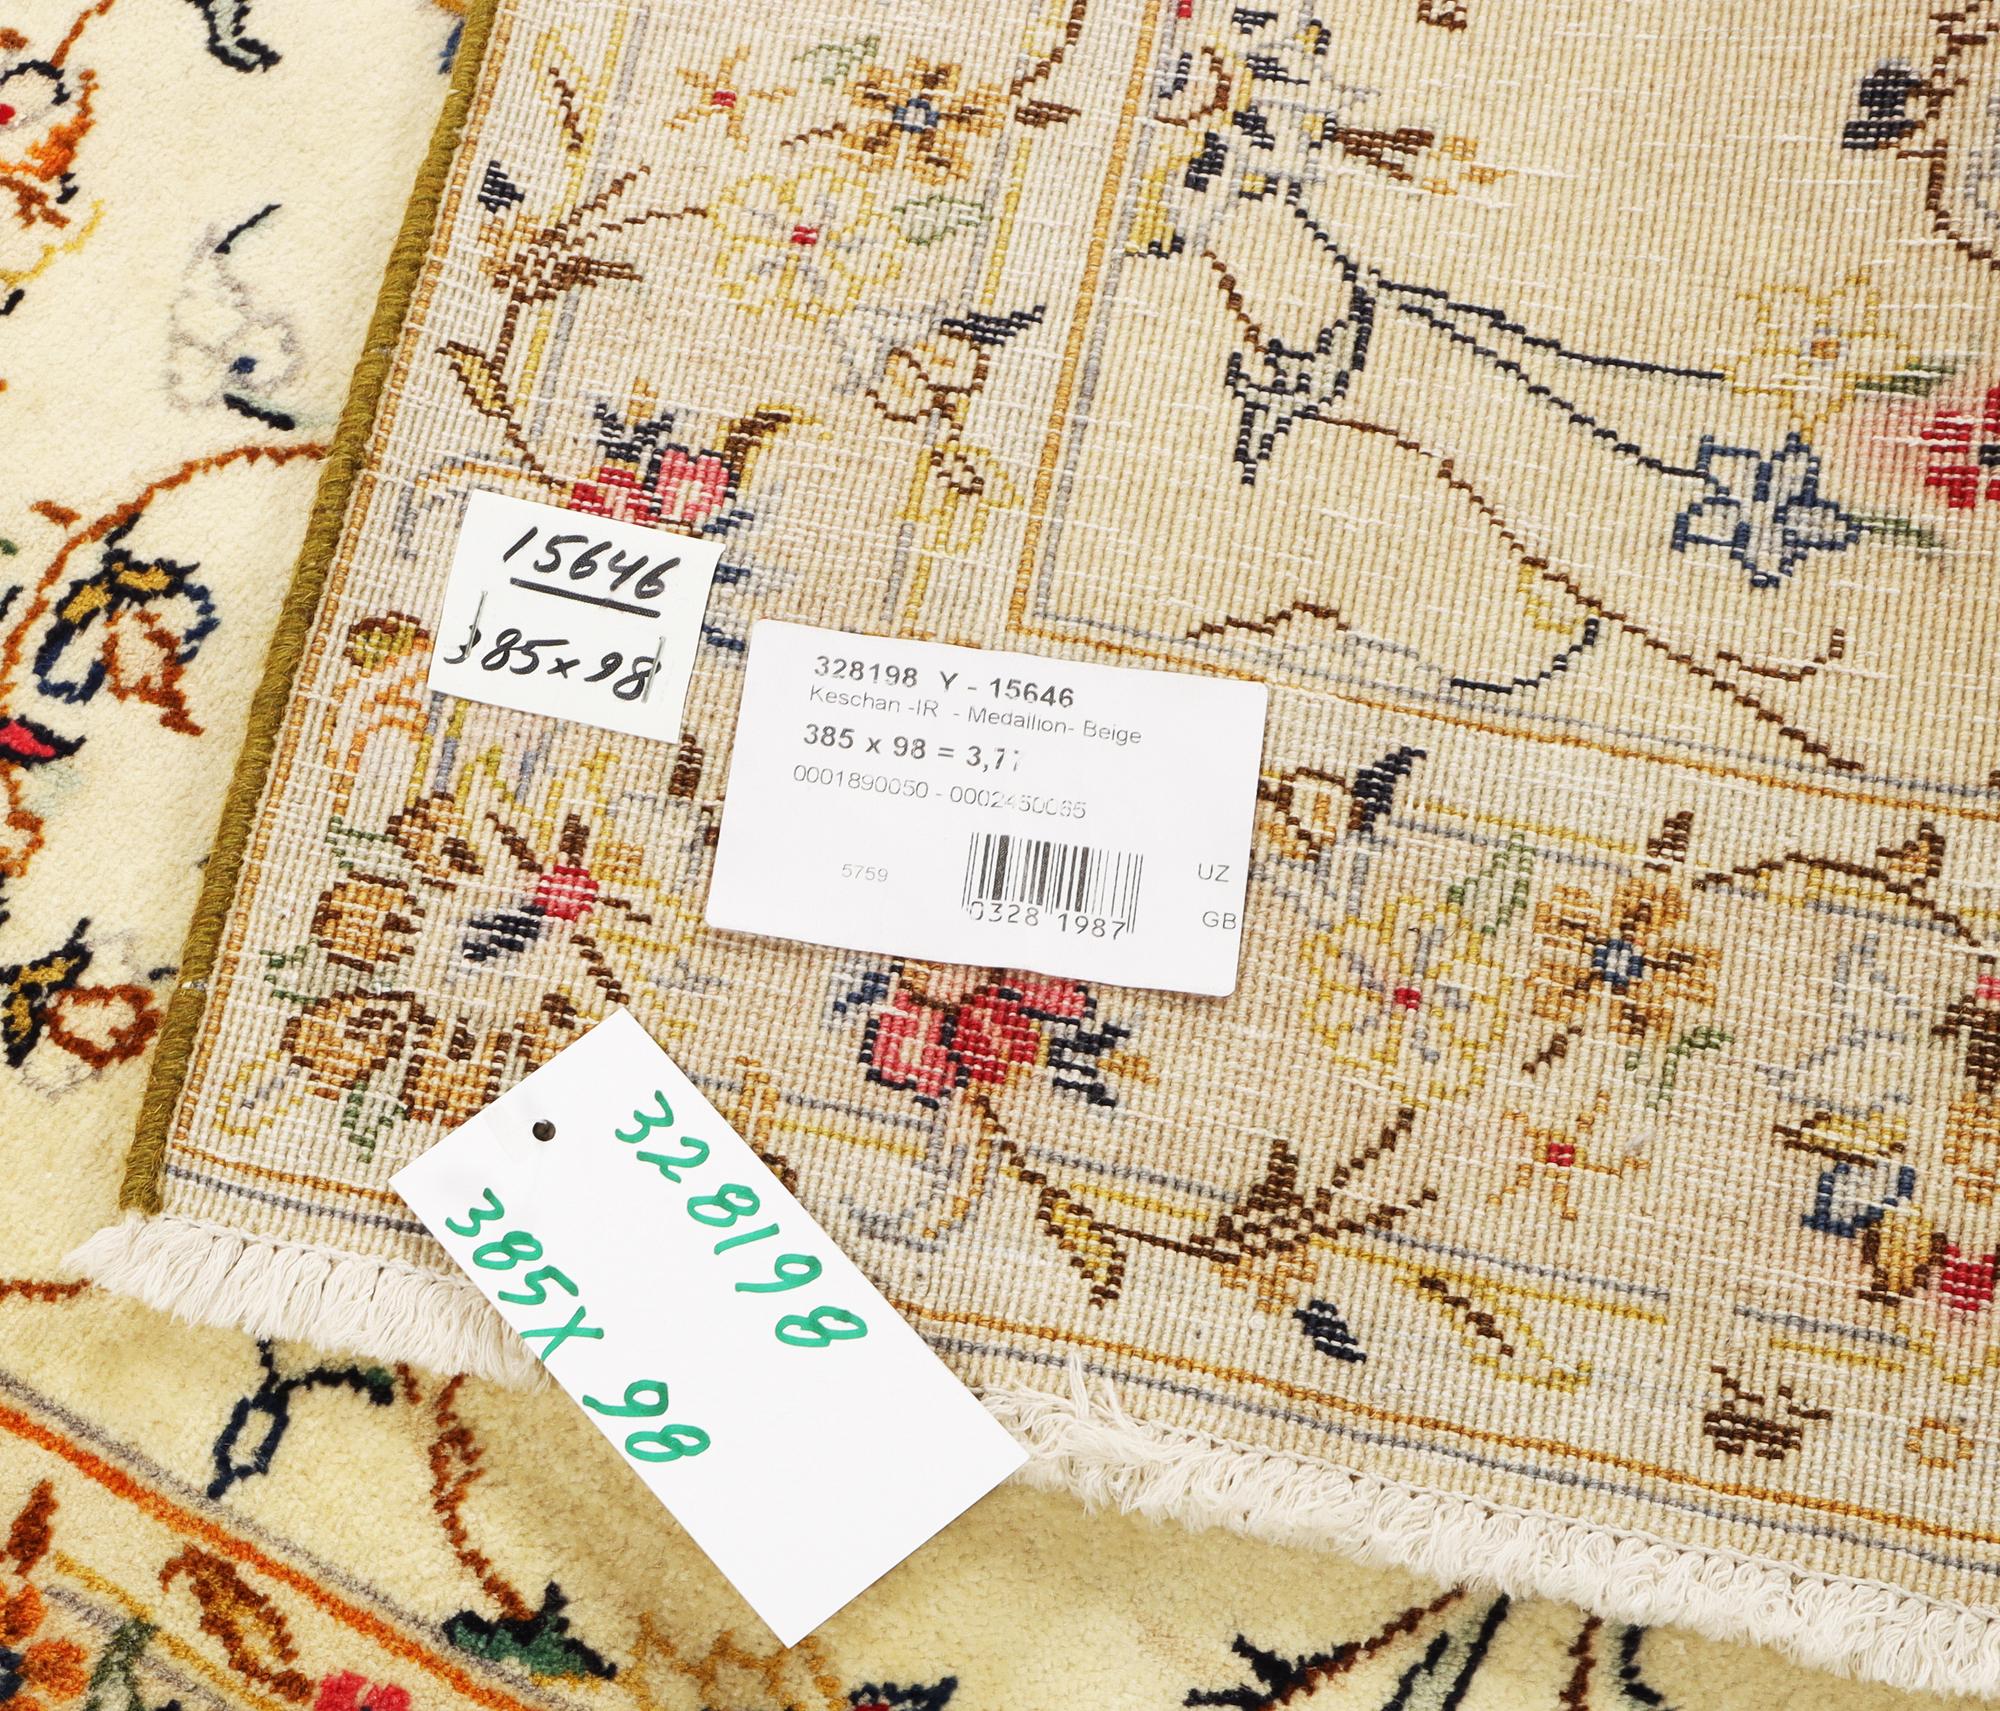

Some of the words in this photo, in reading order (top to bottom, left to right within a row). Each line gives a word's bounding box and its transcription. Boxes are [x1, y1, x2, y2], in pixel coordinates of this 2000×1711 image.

[503, 526, 681, 600] 15646
[813, 655, 918, 688] 328198
[940, 670, 959, 692] Y
[989, 677, 1075, 708] 15646
[809, 684, 901, 713] Keschan
[1083, 720, 1142, 747] Beige
[803, 723, 855, 750] 385
[865, 737, 882, 755] x
[893, 735, 926, 760] 98
[937, 747, 955, 759] =
[793, 764, 929, 799] 0001890050
[841, 863, 889, 882] 5759
[1198, 862, 1230, 883] UZ
[968, 900, 1040, 927] 0328
[1057, 913, 1127, 941] 1987
[1202, 910, 1237, 930] GB
[614, 1090, 869, 1348] 328198
[582, 1379, 711, 1463] 98
